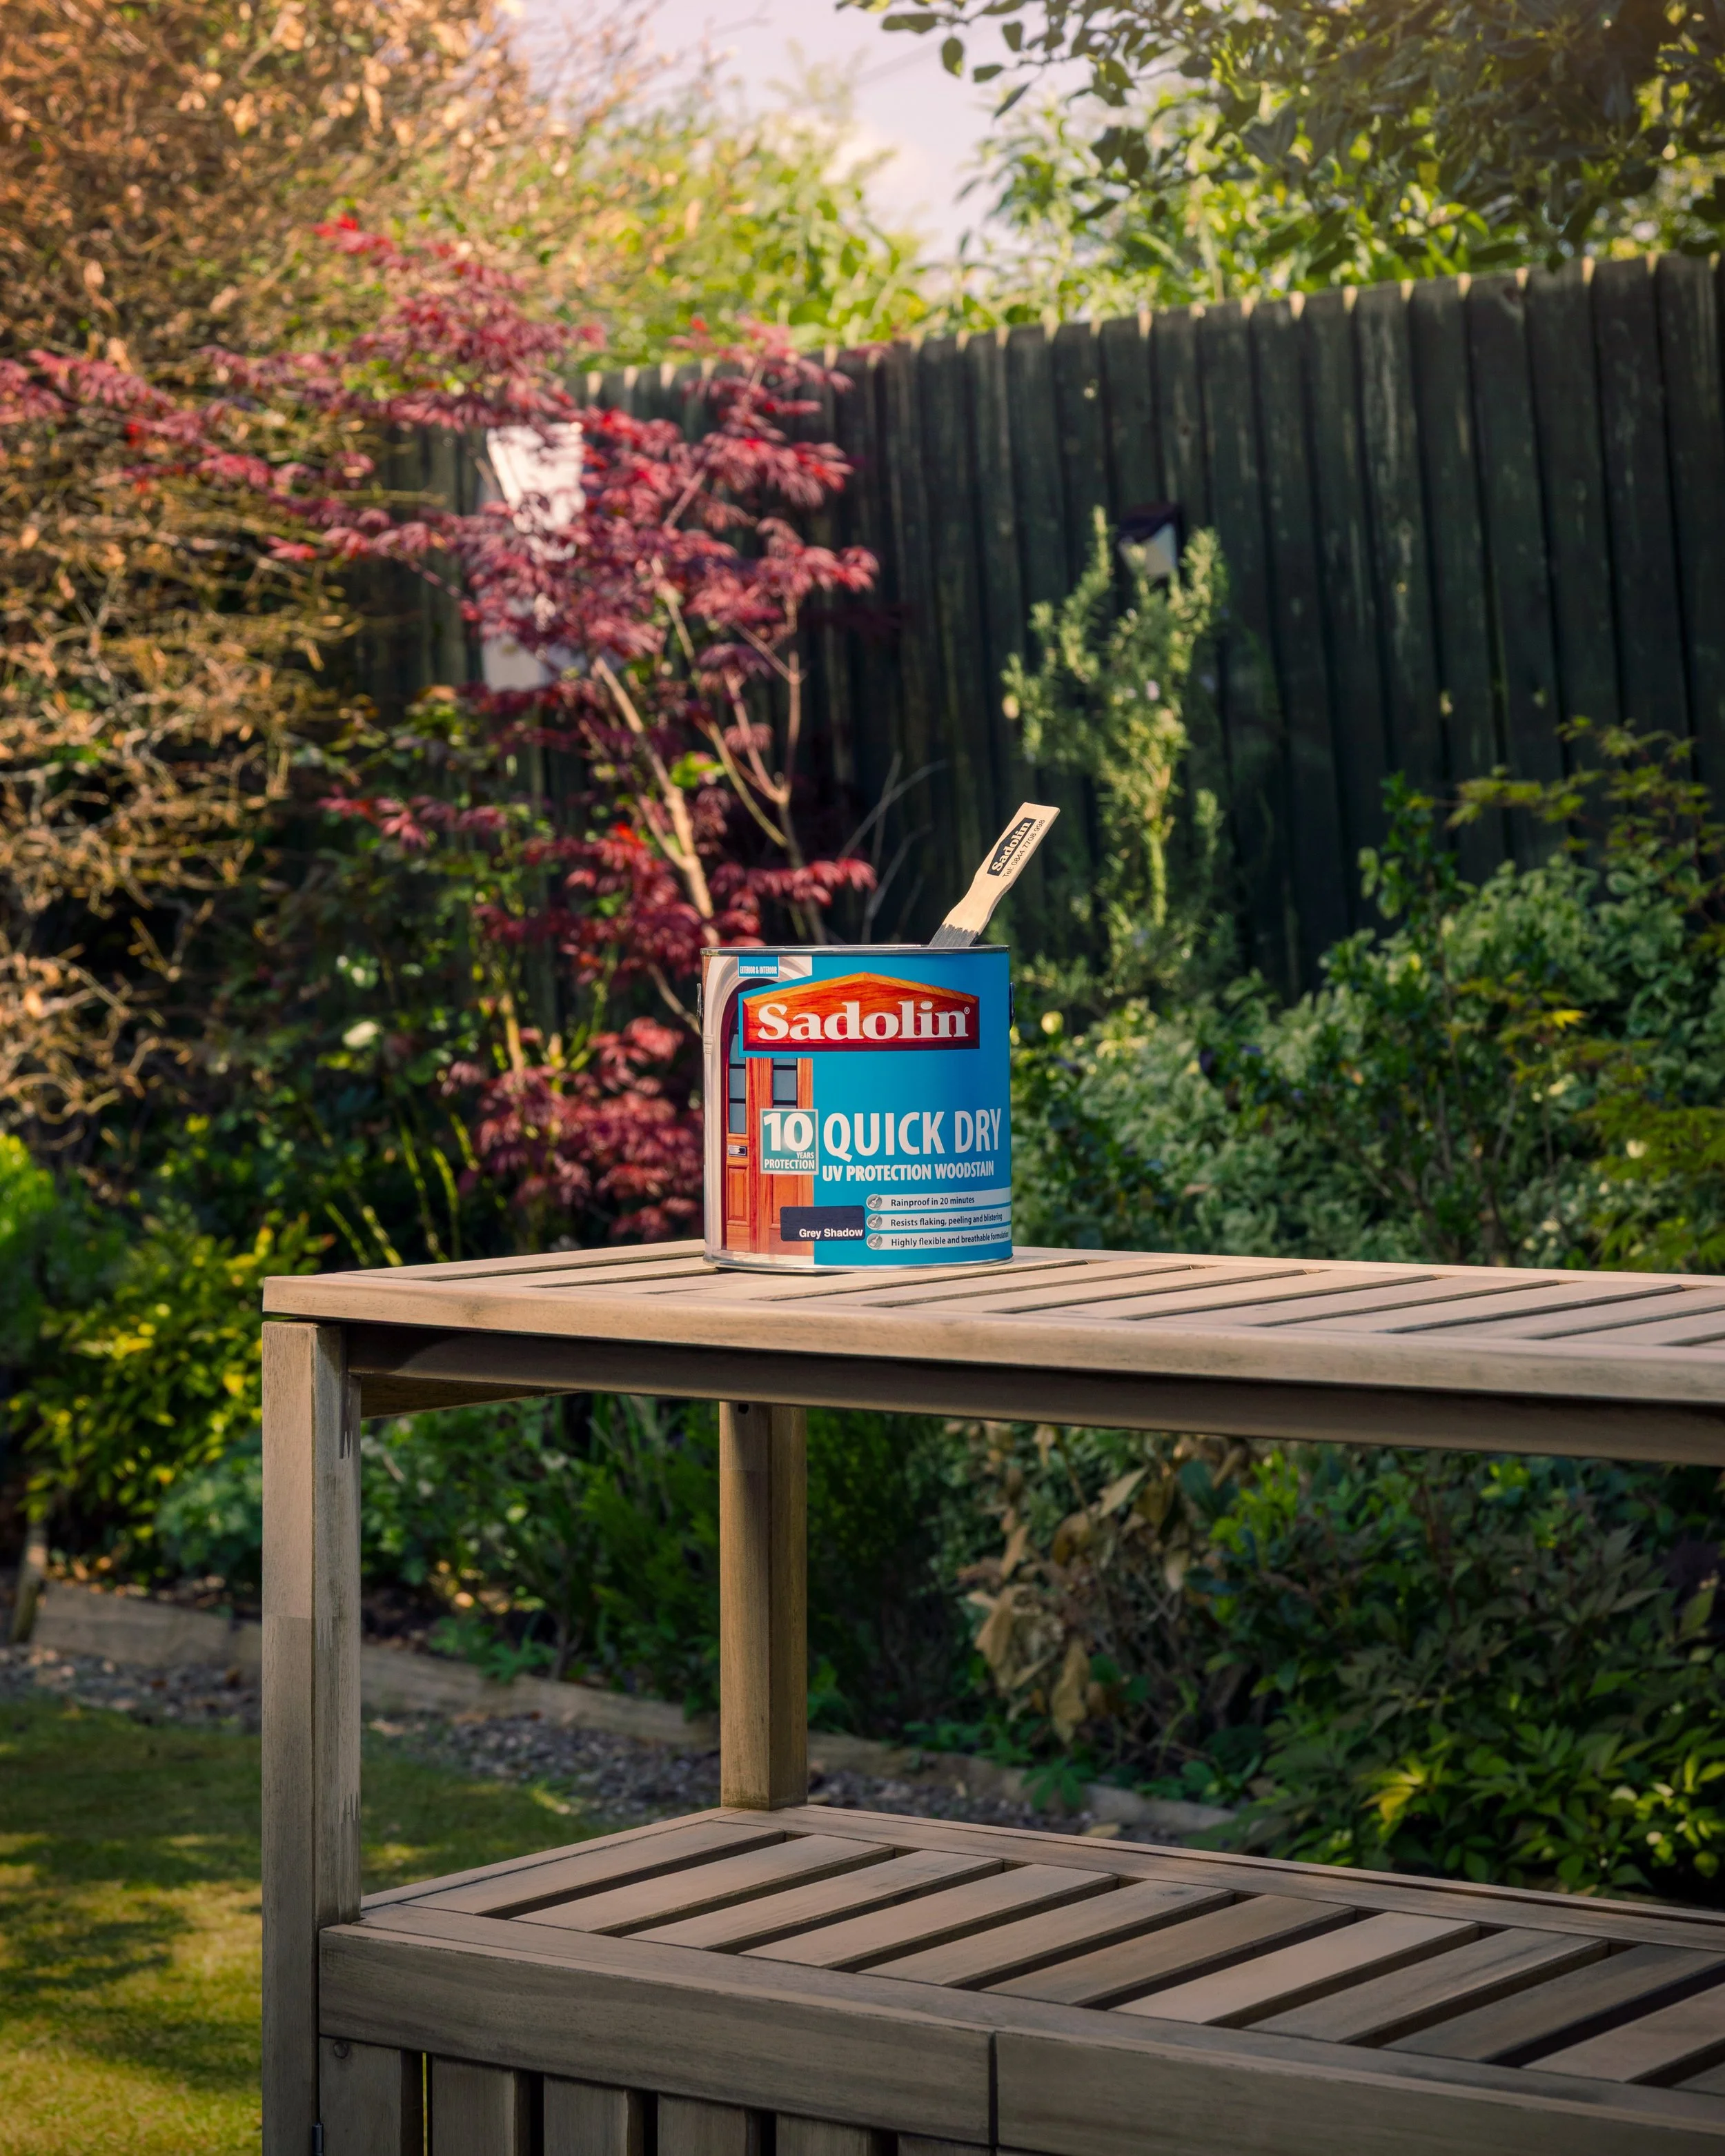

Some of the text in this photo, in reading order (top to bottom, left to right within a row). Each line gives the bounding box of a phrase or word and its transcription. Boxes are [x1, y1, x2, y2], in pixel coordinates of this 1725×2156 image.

[992, 822, 1032, 871] Sadolin
[1012, 850, 1025, 866] 0844
[1023, 833, 1036, 849] 7708
[1034, 820, 1045, 831] 998
[756, 966, 759, 974] &
[760, 966, 777, 974] INTERIOR
[763, 1112, 814, 1152] 10
[823, 1108, 1001, 1163] QUICK DRY
[764, 1159, 815, 1169] PROTECTION
[822, 1160, 994, 1182] UV PROTECTION WOODSTAIN
[891, 1198, 929, 1207] Rainproof
[950, 1196, 975, 1205] minutes
[891, 1213, 1003, 1227] Resists flaking, peeling and blistering
[799, 1228, 863, 1239] Grey Shadow
[891, 1231, 1009, 1247] Highly flexible and breathable formulation
